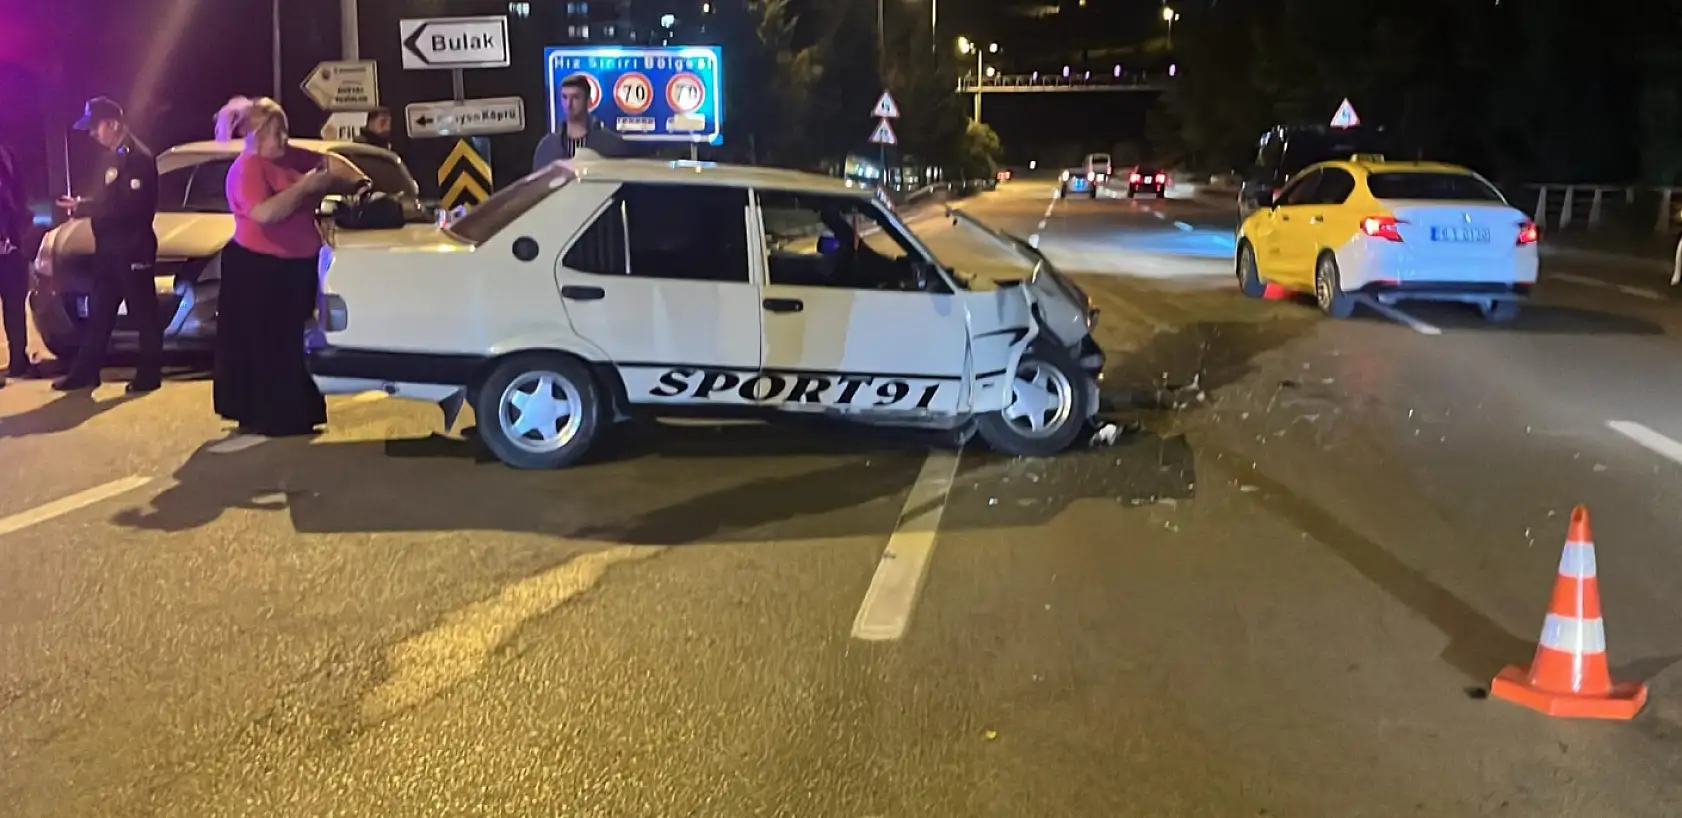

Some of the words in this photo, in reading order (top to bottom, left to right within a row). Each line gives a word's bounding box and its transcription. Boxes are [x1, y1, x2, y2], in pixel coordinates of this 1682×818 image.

[431, 32, 495, 52] Bulak
[622, 84, 646, 104] 70
[676, 84, 699, 102] 70
